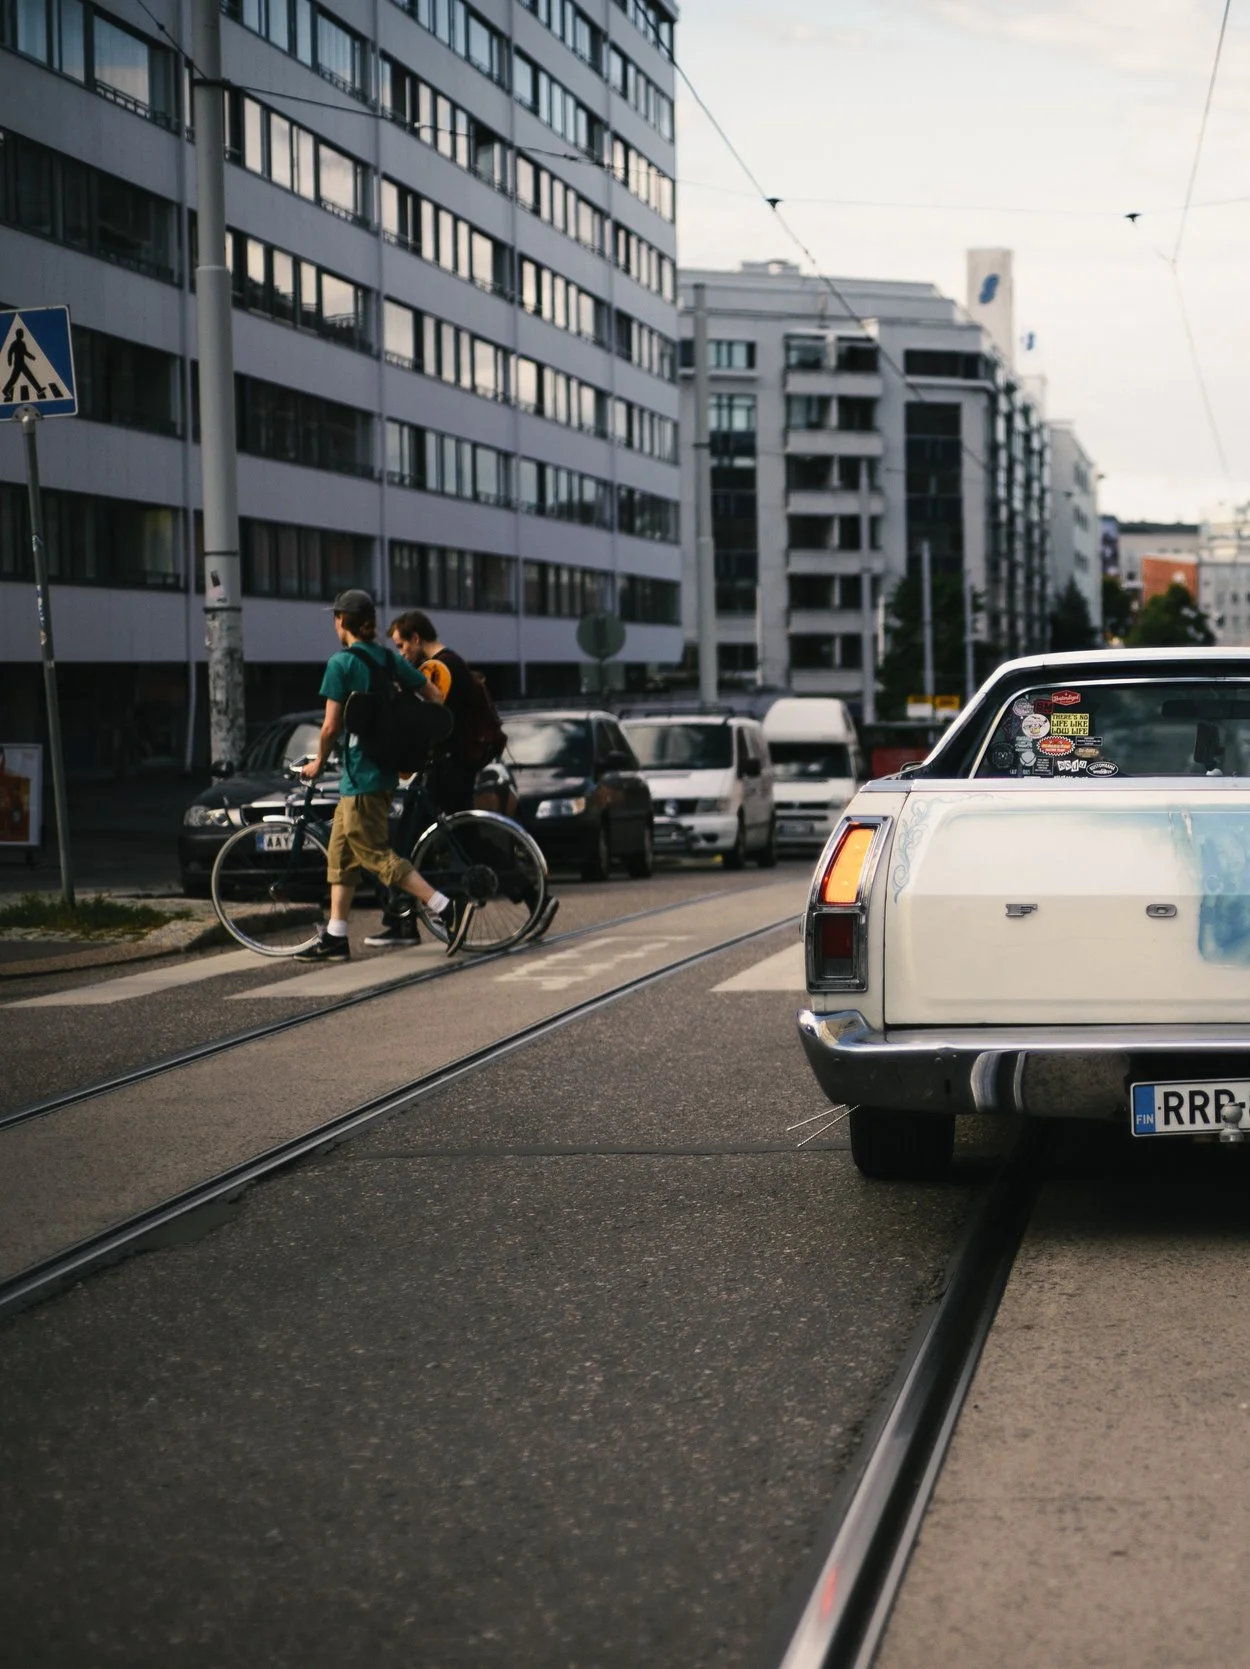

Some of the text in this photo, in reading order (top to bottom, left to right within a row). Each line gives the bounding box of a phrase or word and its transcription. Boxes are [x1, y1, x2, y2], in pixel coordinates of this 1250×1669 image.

[1051, 720, 1088, 728] LIFE LIKE
[1051, 727, 1088, 735] LOW LIFE
[1136, 1114, 1154, 1126] FIN
